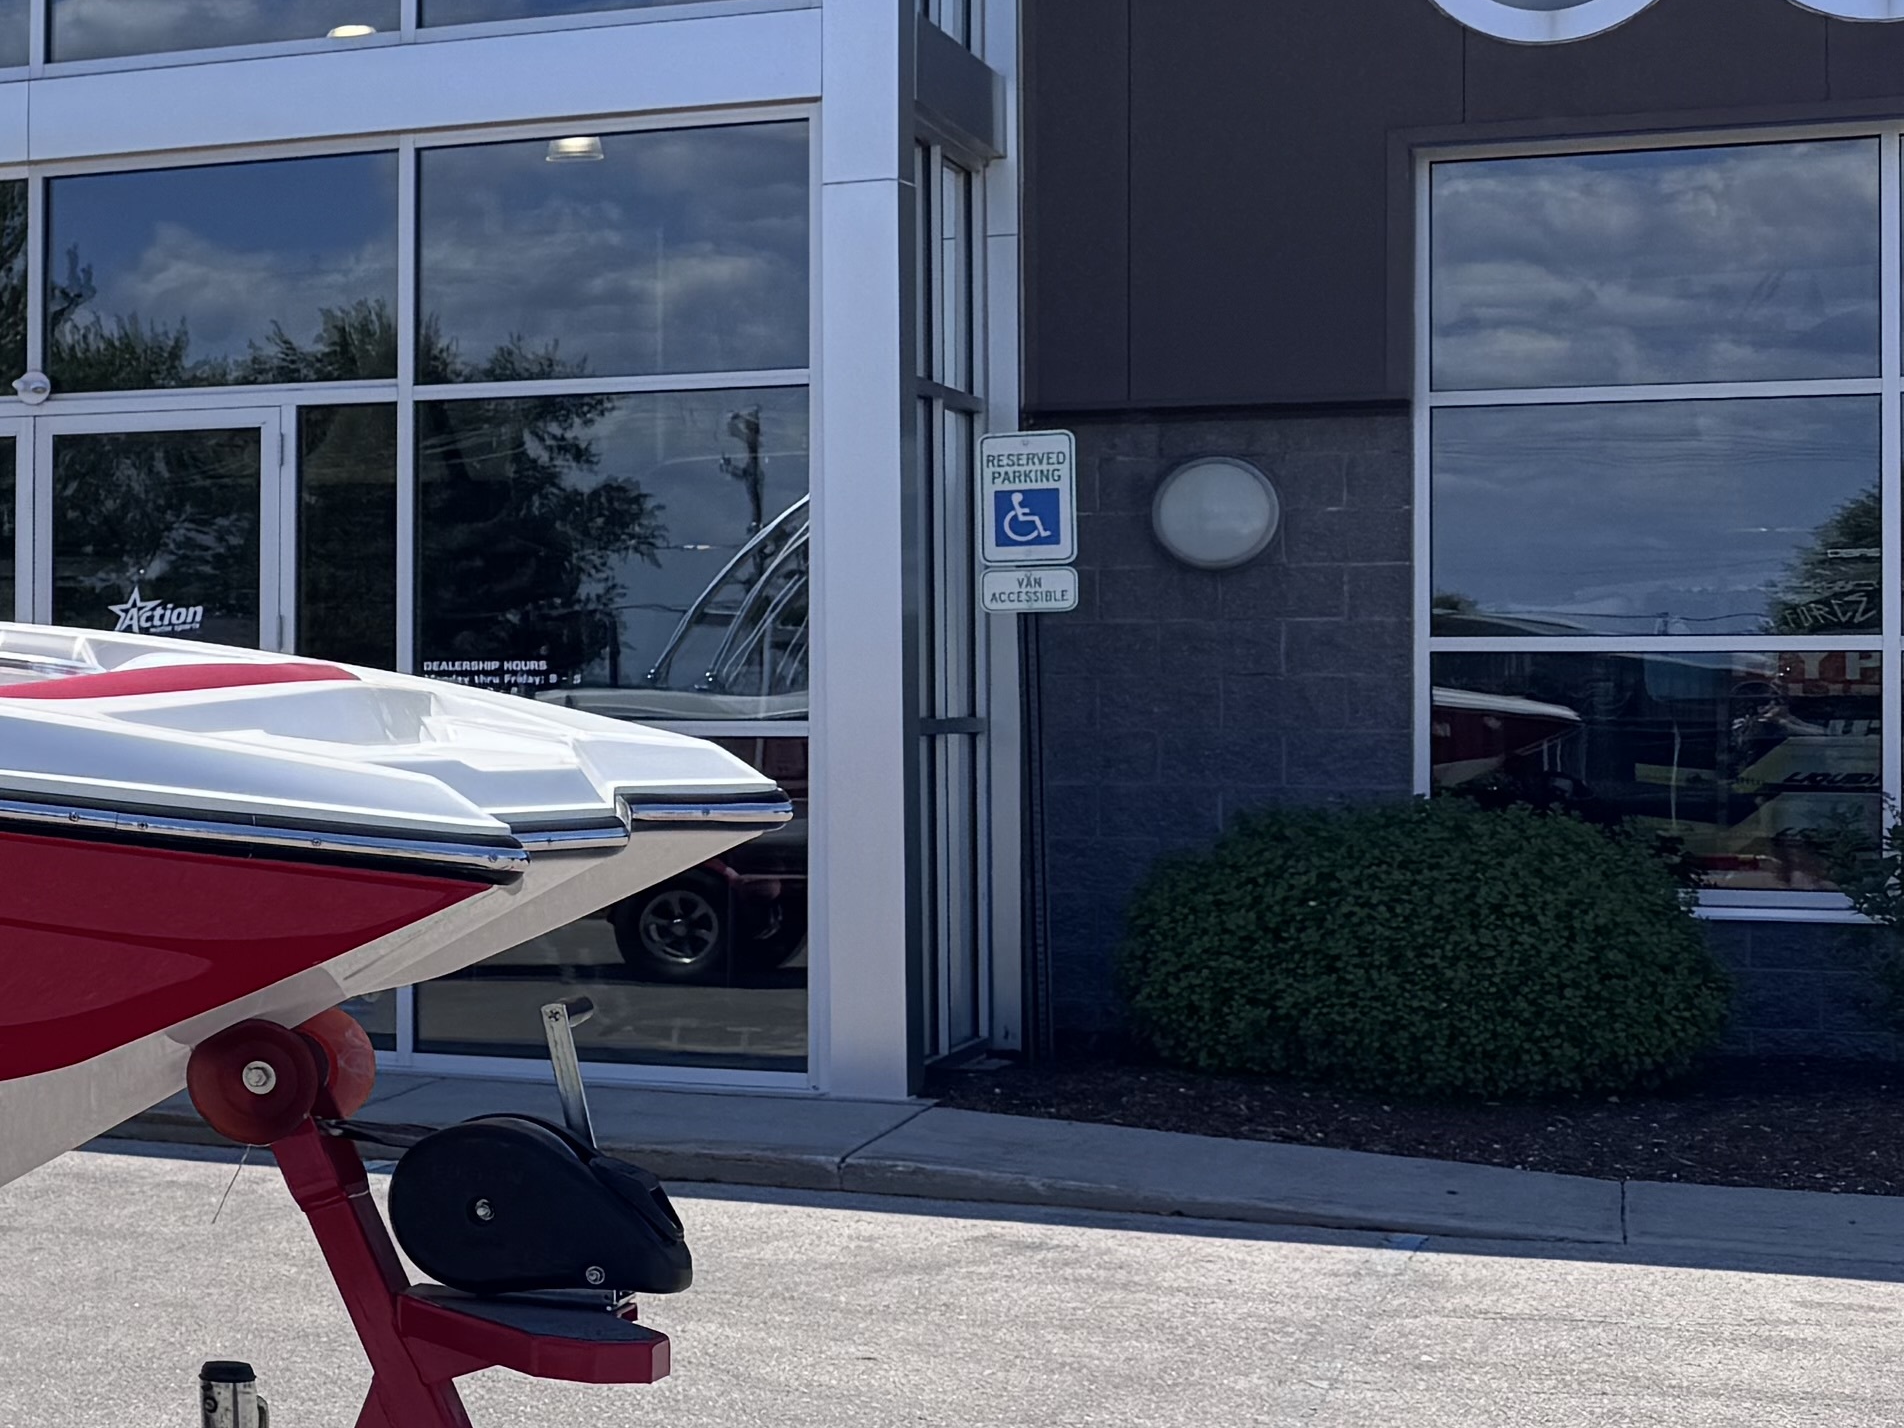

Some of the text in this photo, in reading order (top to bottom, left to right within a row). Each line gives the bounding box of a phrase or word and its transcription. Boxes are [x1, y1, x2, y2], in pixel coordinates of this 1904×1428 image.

[986, 451, 1066, 469] RESERVED
[992, 469, 1062, 485] PARKING
[1017, 577, 1042, 589] VAN
[990, 590, 1069, 603] ACCESSIBLE
[119, 603, 204, 634] Action
[423, 660, 547, 671] DEALERSHIP HOURS
[474, 674, 499, 684] thru
